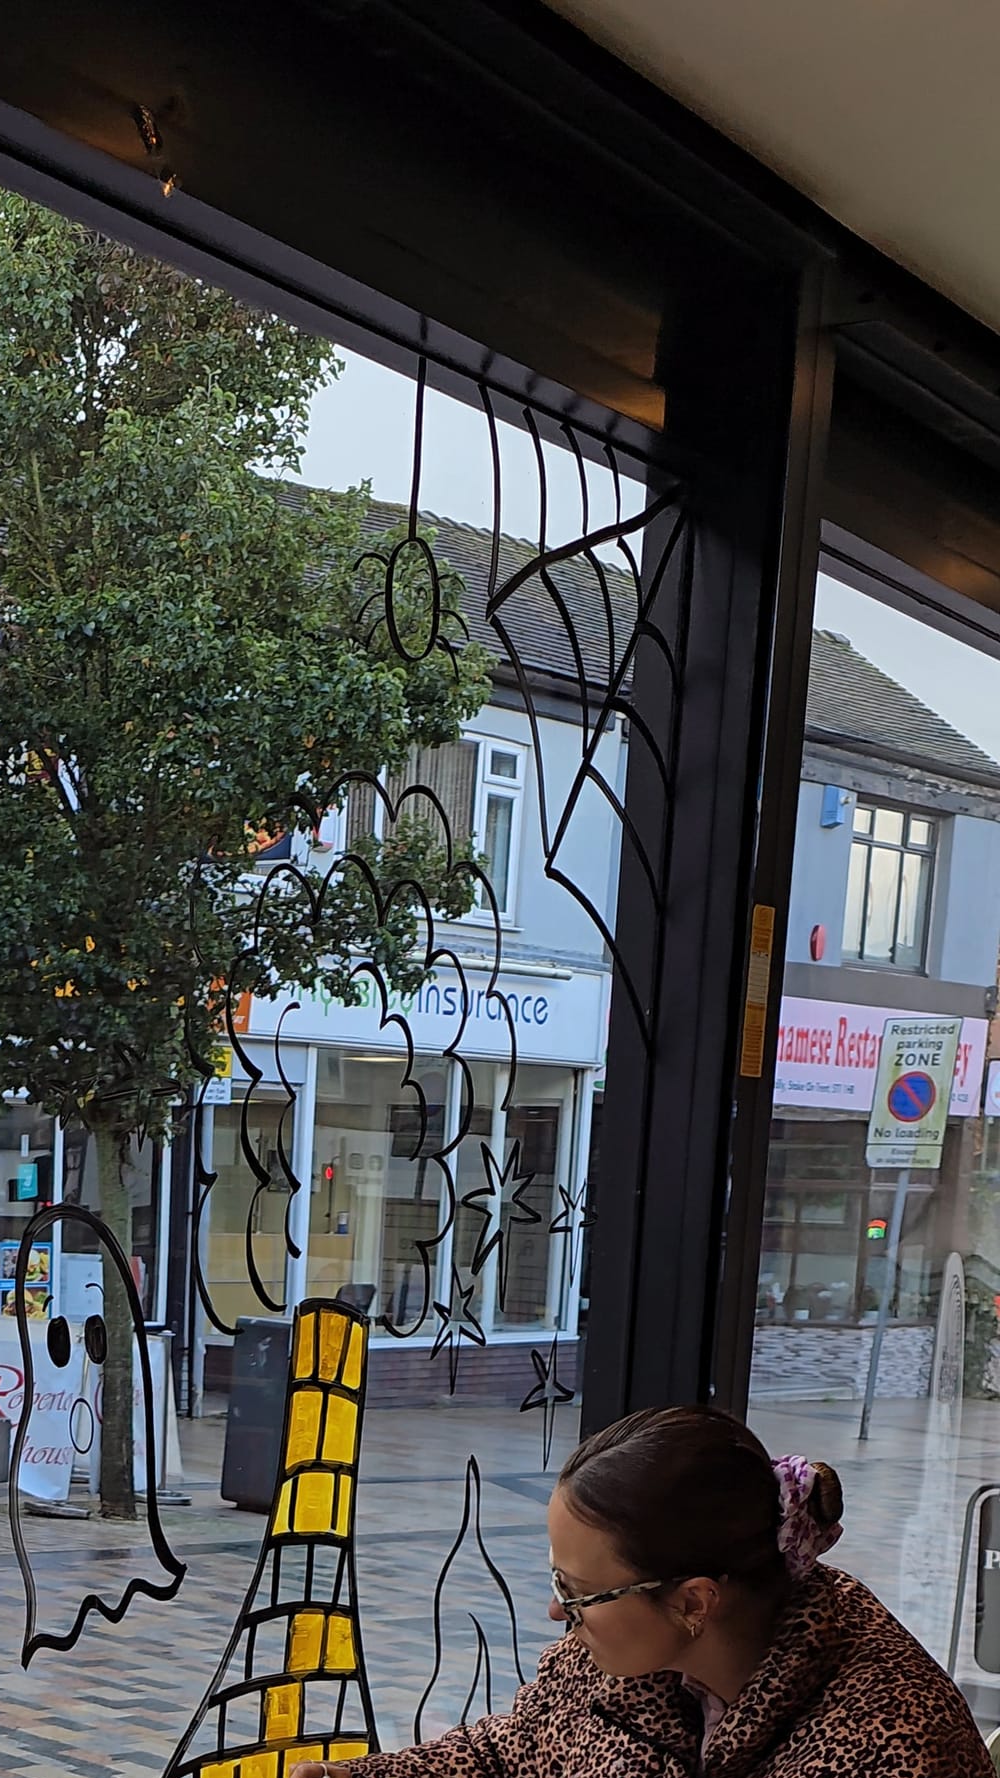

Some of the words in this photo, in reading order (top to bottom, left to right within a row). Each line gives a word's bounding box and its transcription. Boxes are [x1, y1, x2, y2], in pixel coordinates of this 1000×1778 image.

[891, 1024, 954, 1036] Restricted
[835, 1017, 882, 1069] Resta
[897, 1039, 943, 1051] parking
[894, 1053, 941, 1066] ZONE
[873, 1127, 891, 1138] No
[896, 1127, 940, 1141] loading
